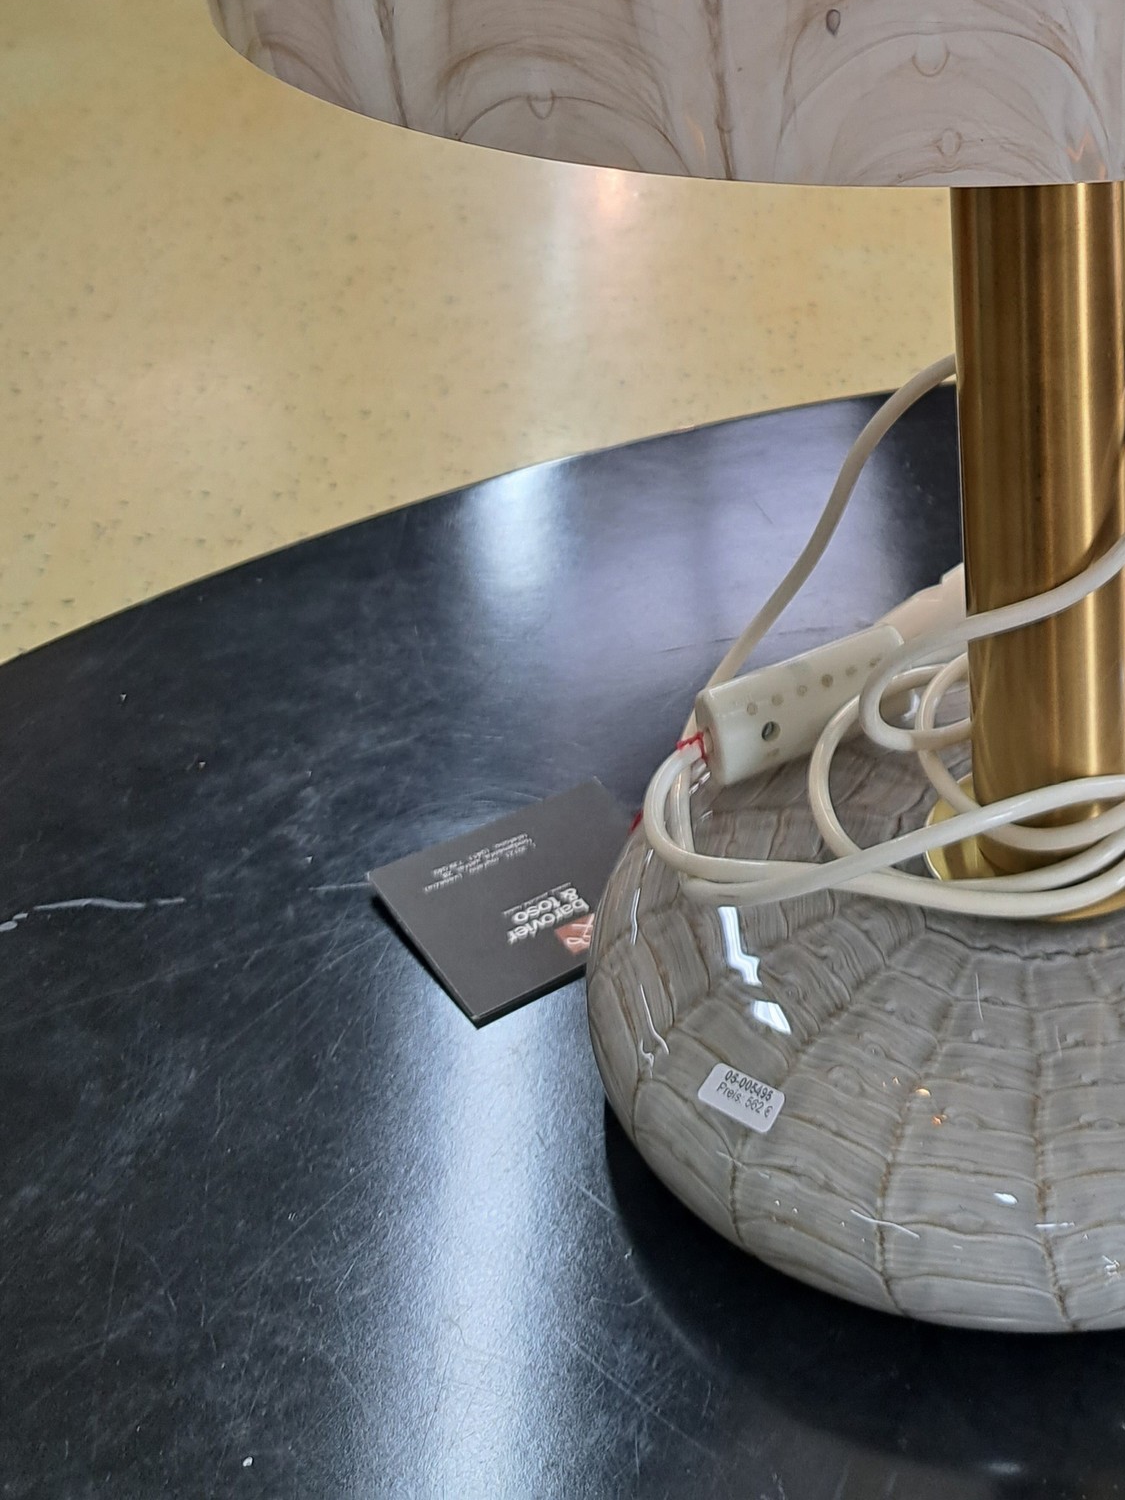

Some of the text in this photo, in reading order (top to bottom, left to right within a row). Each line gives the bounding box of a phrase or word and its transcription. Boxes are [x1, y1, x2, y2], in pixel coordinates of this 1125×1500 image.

[560, 888, 578, 902] &
[512, 897, 560, 924] toso
[507, 898, 589, 944] barovier
[764, 1105, 773, 1118] €
